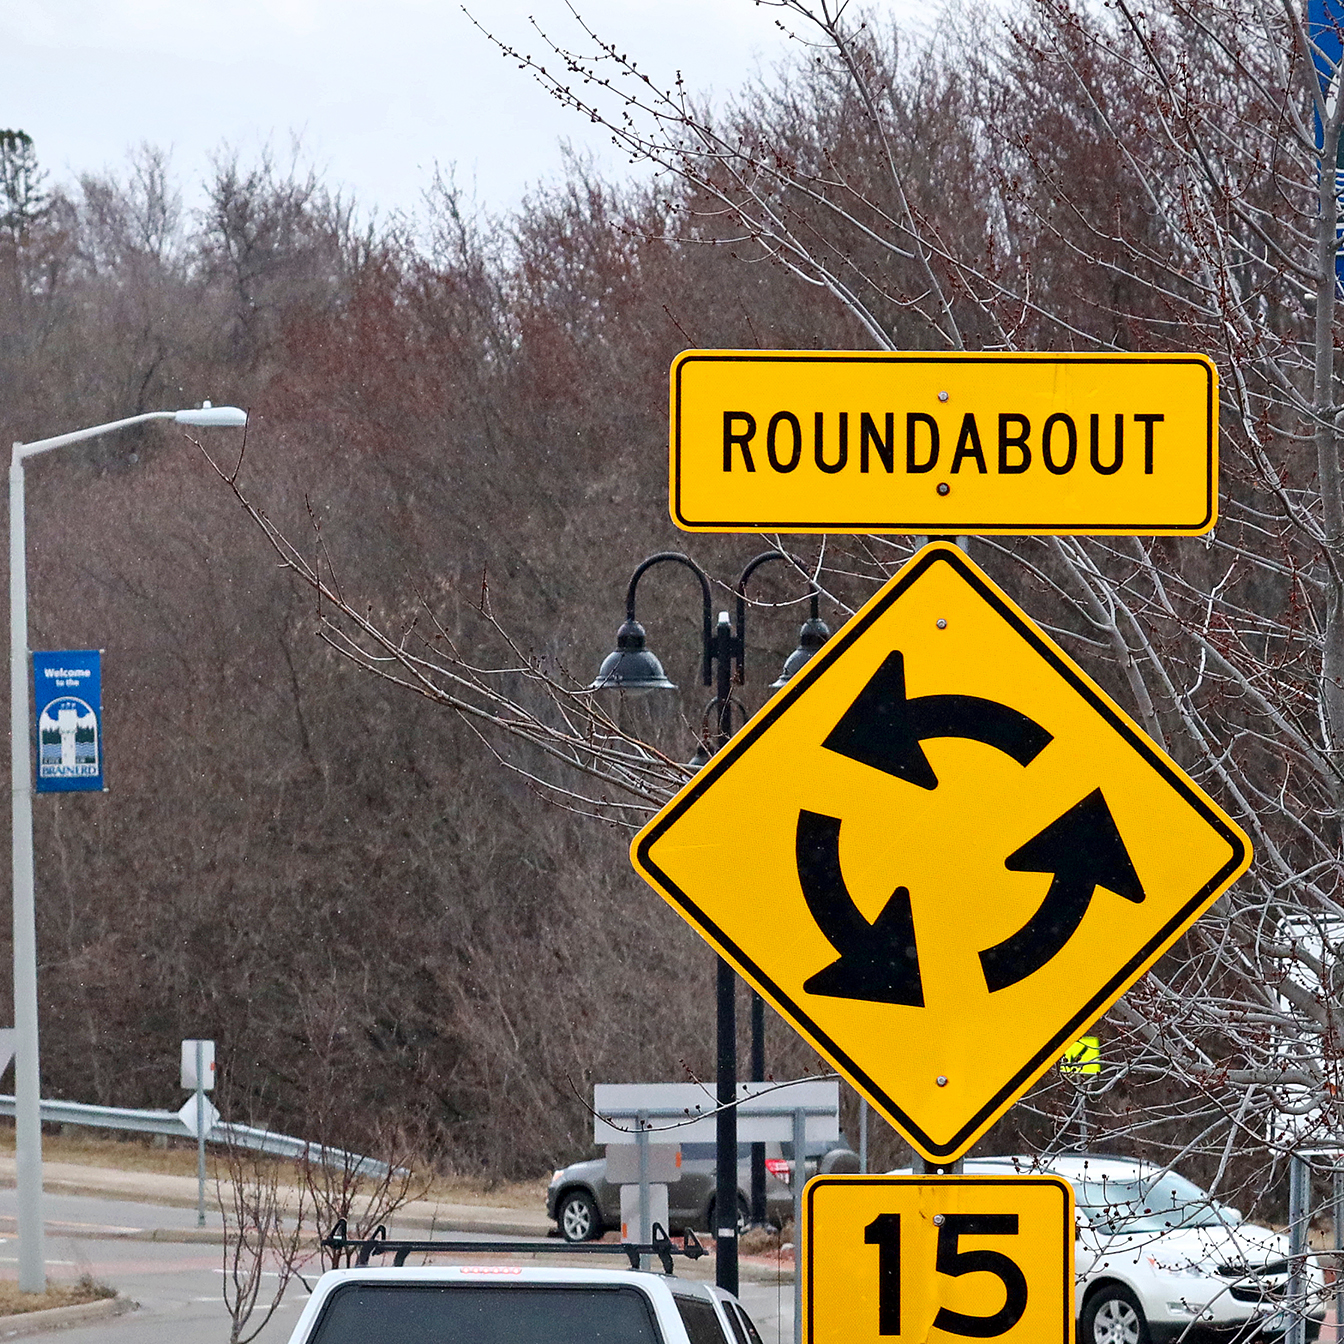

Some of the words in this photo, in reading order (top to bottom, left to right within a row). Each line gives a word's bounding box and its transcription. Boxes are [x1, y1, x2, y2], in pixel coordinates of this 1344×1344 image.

[721, 410, 1165, 476] ROUNDABOUT
[44, 667, 92, 678] Welcome
[56, 679, 65, 687] to
[66, 678, 80, 687] the
[42, 766, 97, 776] BRAINERD
[863, 1212, 1029, 1339] 15
